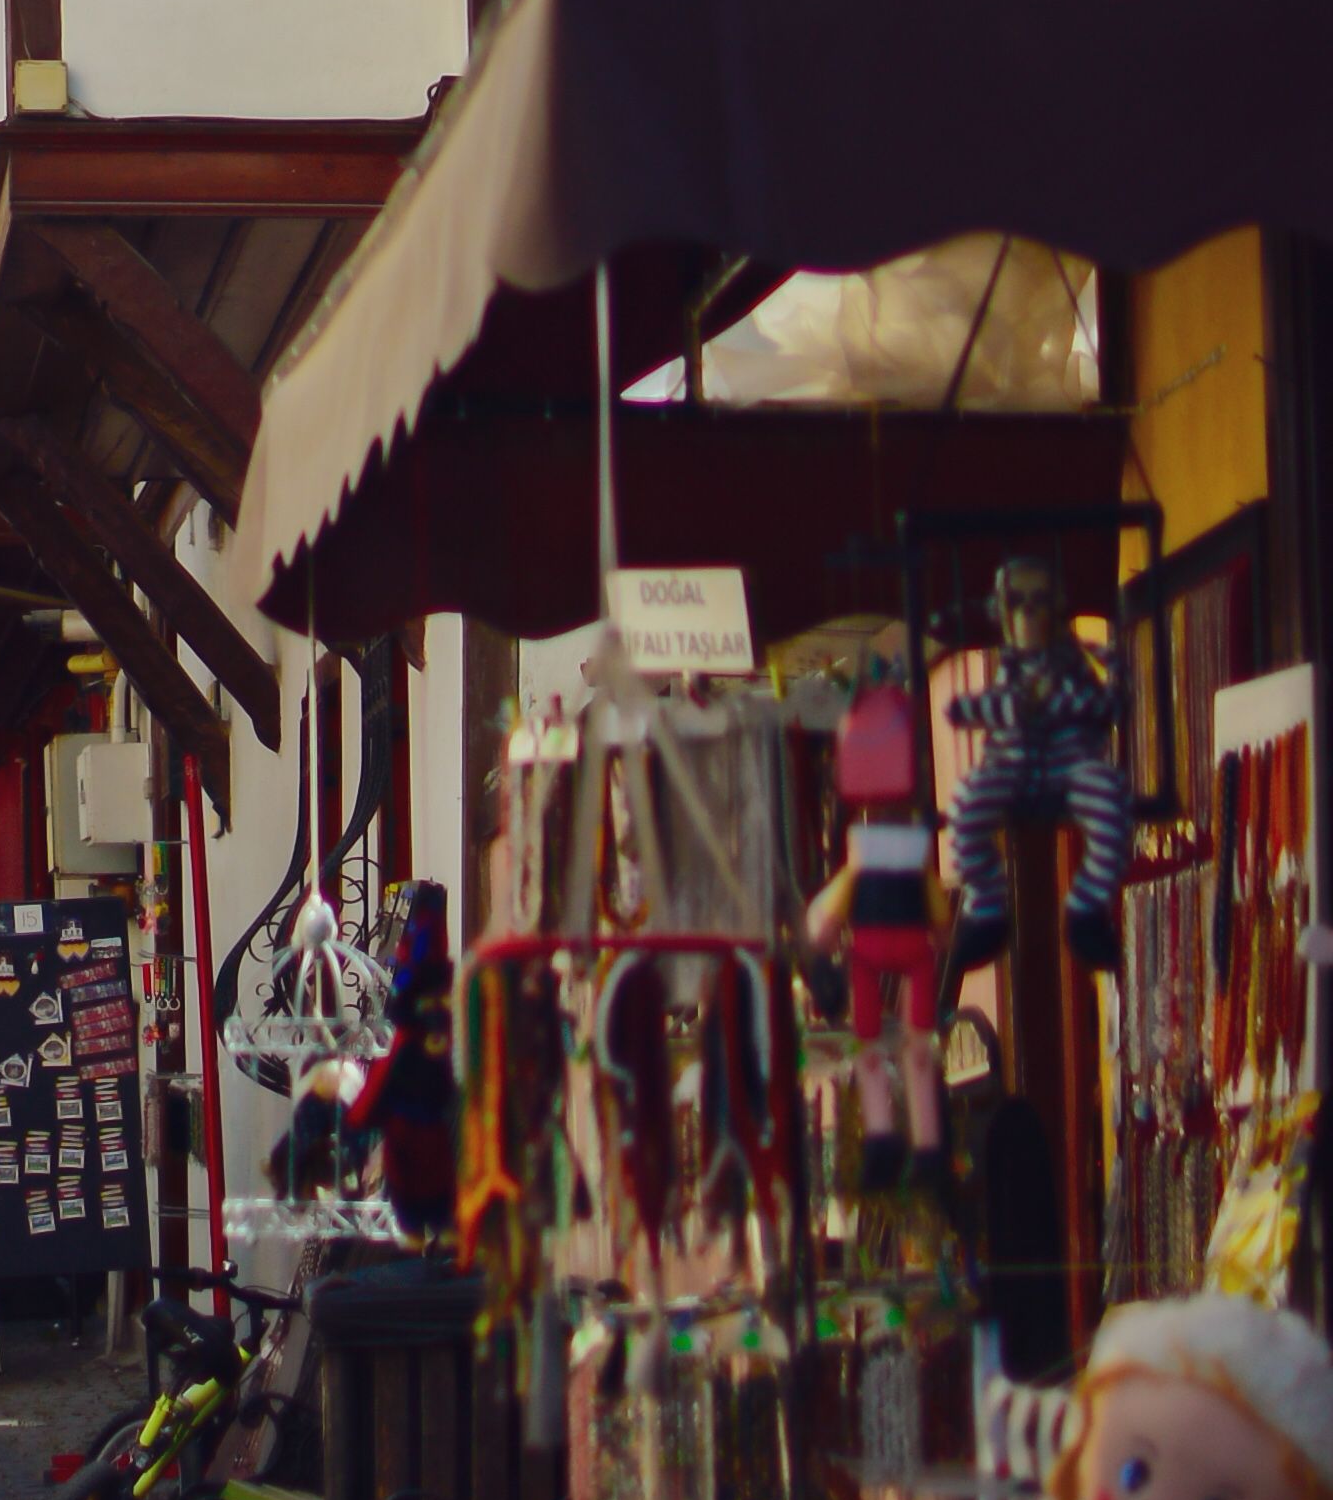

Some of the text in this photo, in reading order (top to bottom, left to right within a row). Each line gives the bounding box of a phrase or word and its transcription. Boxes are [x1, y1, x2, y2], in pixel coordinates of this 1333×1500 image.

[639, 575, 706, 605] DOĞAL
[676, 631, 747, 661] TAŞLAR
[21, 911, 38, 928] 15
